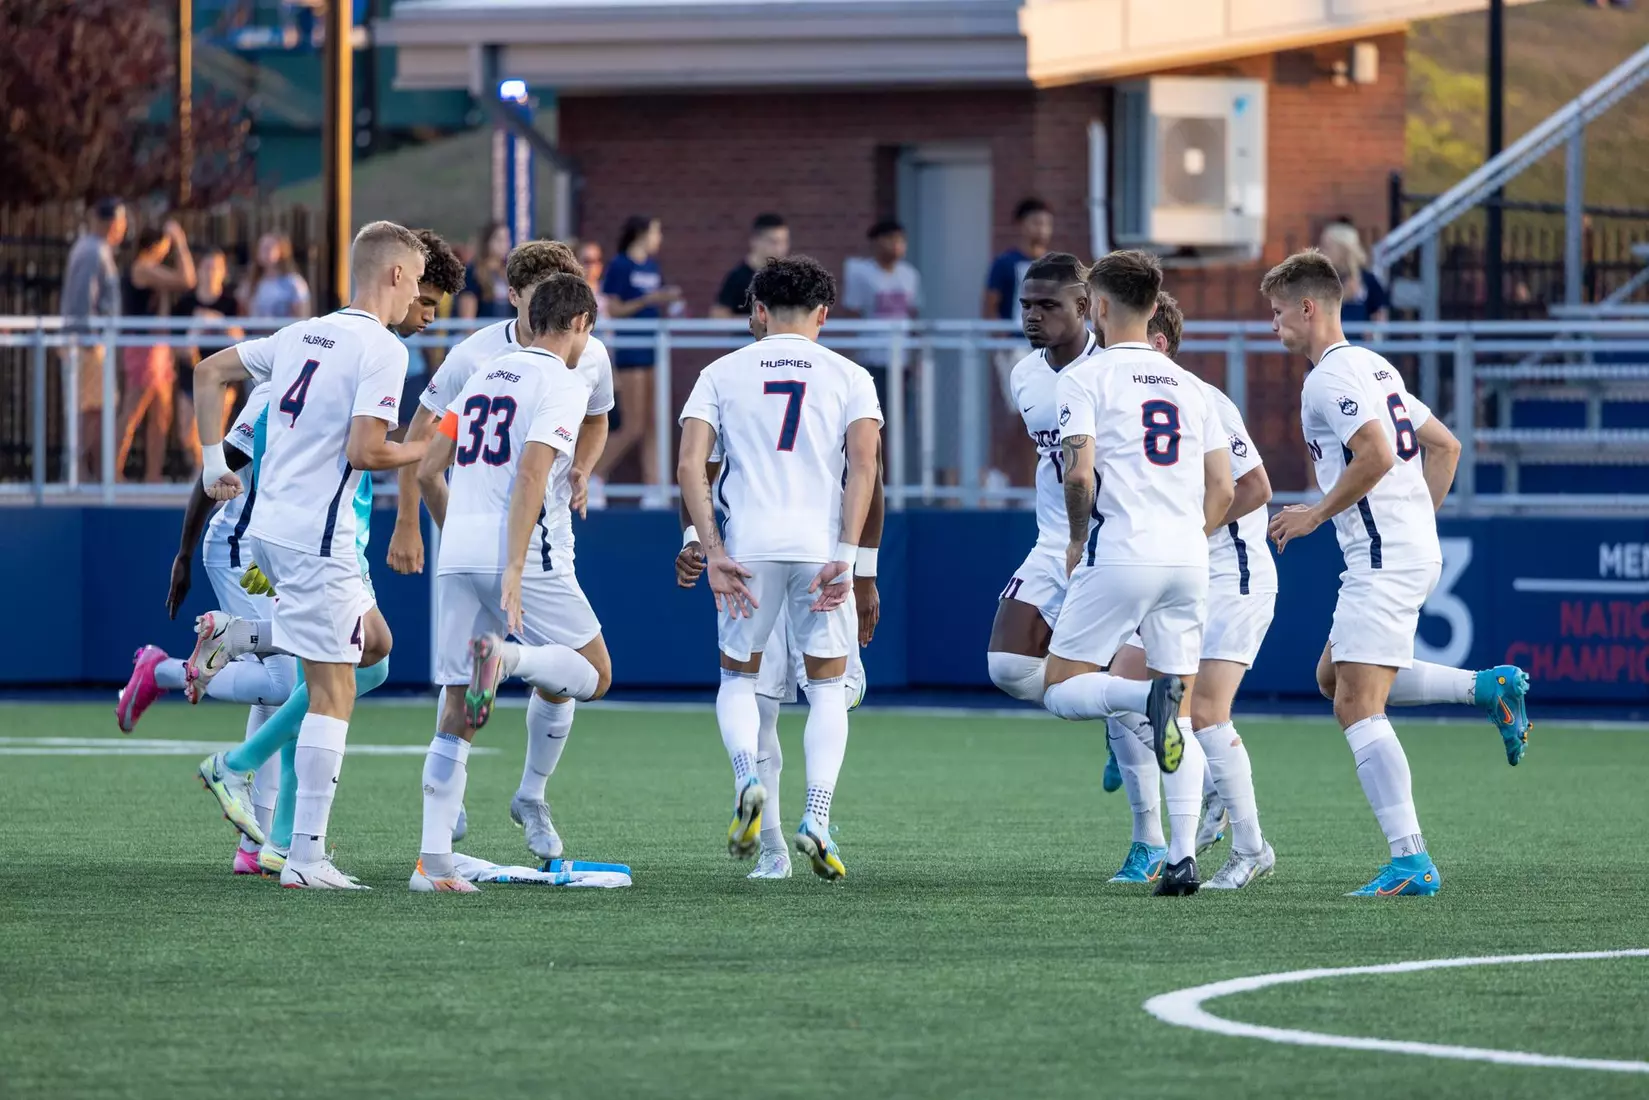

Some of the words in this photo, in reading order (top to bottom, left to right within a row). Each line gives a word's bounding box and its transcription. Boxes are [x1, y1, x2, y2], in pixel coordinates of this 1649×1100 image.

[302, 333, 336, 349] HUSKIES
[760, 358, 812, 369] HUSKIES
[279, 358, 321, 429] 4
[485, 369, 521, 383] HUSKIES
[1132, 374, 1179, 387] HUSKIES
[456, 393, 518, 468] 33
[763, 379, 807, 452] 7
[1141, 399, 1182, 467] 8
[1386, 392, 1420, 462] 6
[350, 615, 362, 651] 4
[1414, 536, 1474, 668] 3
